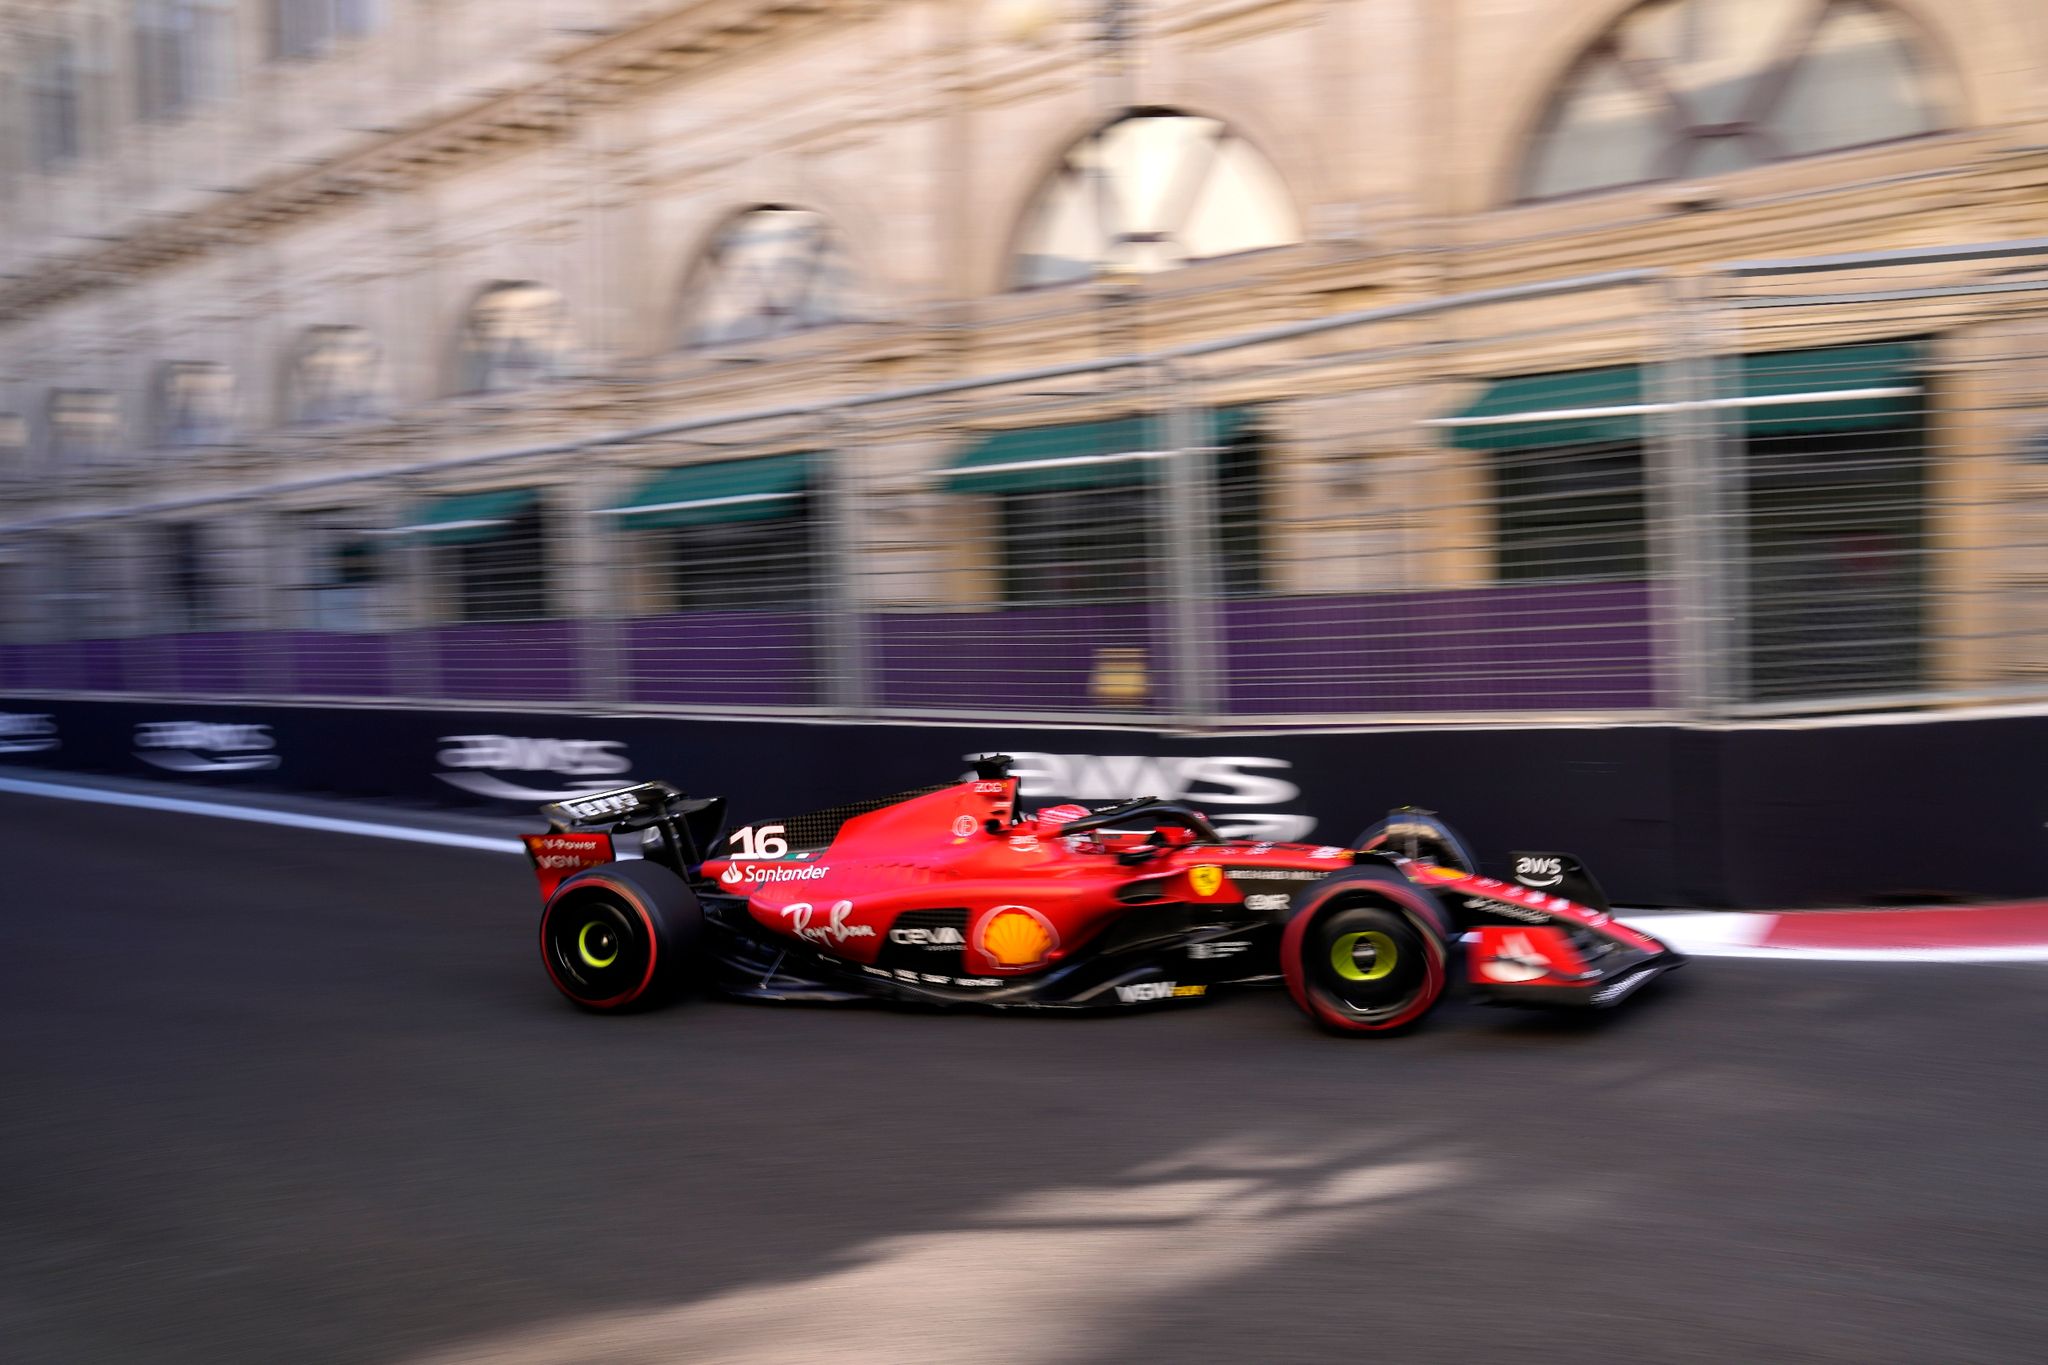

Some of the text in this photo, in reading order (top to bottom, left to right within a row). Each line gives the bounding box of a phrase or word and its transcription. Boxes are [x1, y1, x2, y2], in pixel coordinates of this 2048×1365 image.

[962, 752, 1299, 804] aws
[729, 825, 788, 860] 16
[744, 865, 830, 883] Santander
[1515, 857, 1561, 874] aws
